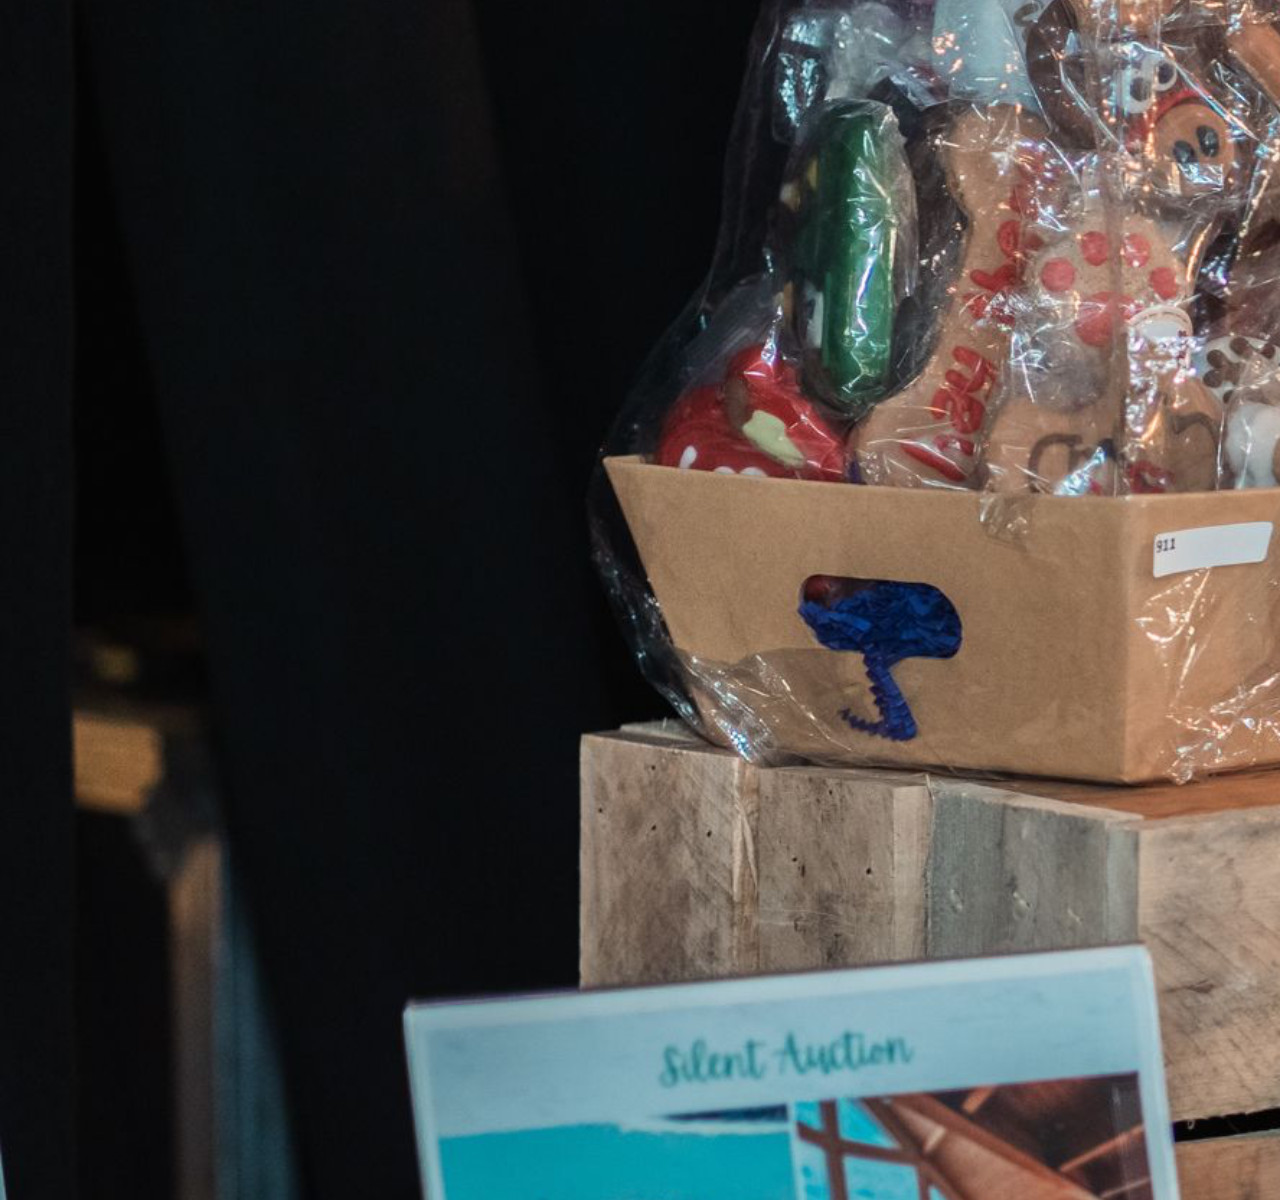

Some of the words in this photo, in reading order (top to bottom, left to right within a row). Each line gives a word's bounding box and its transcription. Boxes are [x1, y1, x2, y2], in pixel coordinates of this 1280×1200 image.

[1156, 538, 1176, 553] 911
[659, 1039, 768, 1087] Silent
[771, 1031, 913, 1075] Auction
